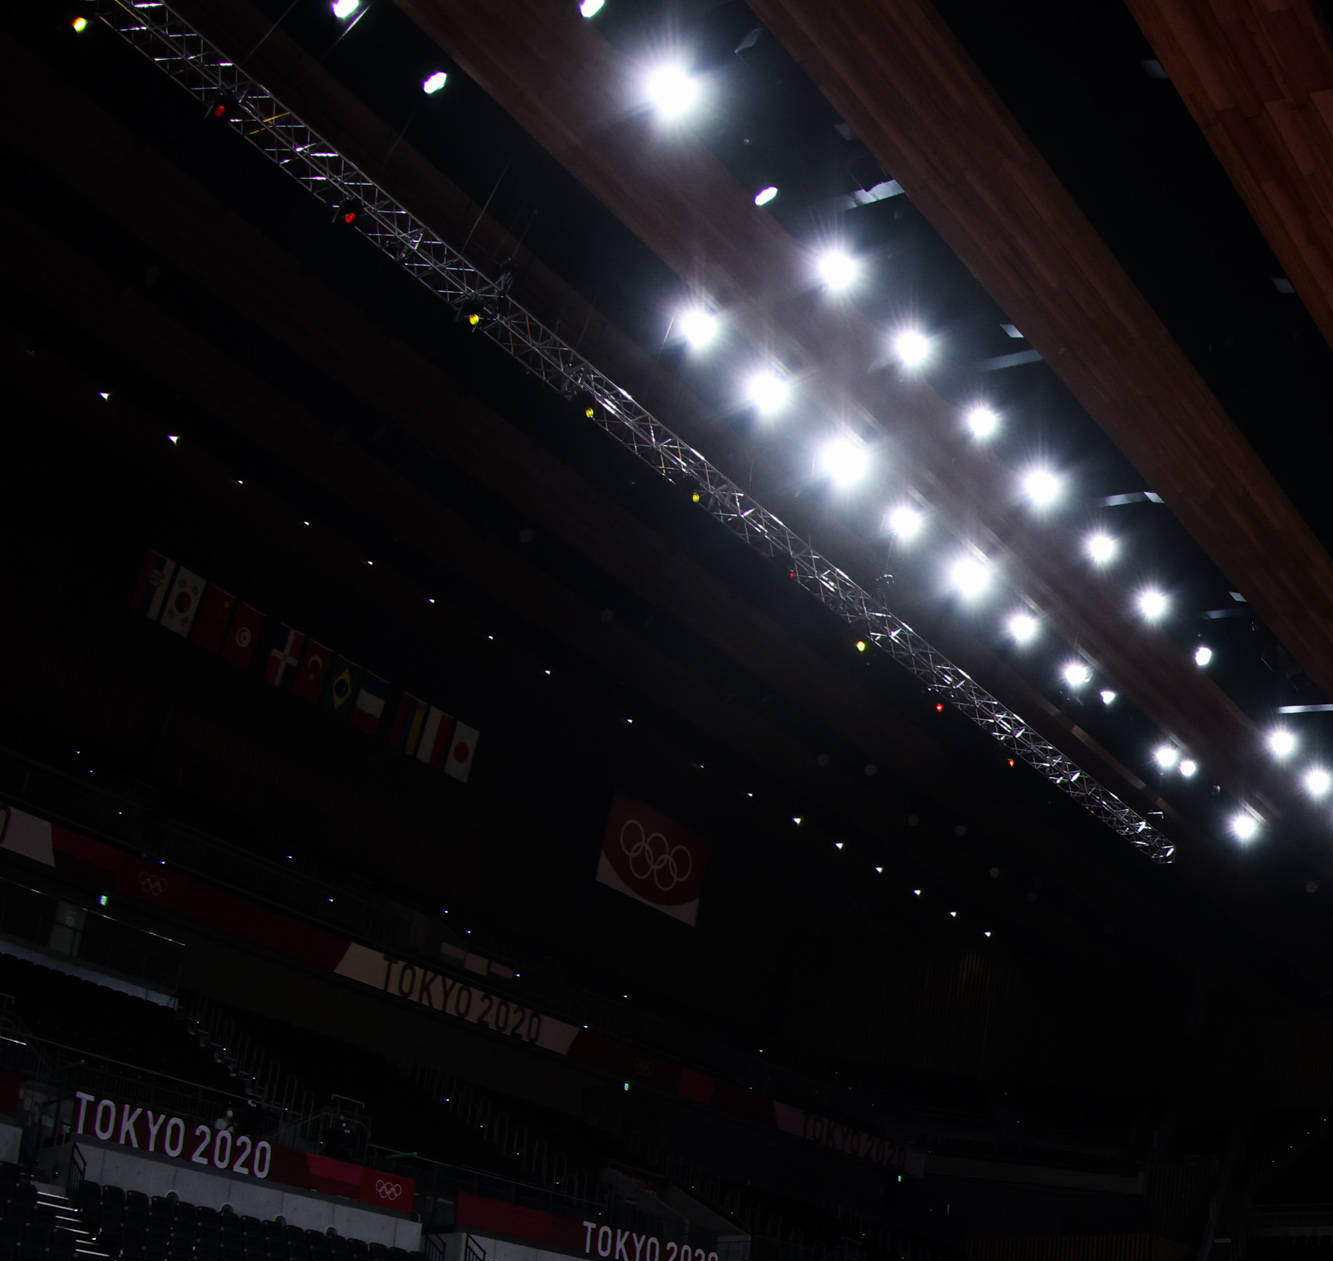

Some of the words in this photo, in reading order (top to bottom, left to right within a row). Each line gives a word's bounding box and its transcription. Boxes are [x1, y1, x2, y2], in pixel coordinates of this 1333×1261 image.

[382, 957, 472, 1020] TOKYO
[476, 996, 541, 1045] 2020
[75, 1090, 186, 1158] TOKYO
[191, 1125, 272, 1180] 2020
